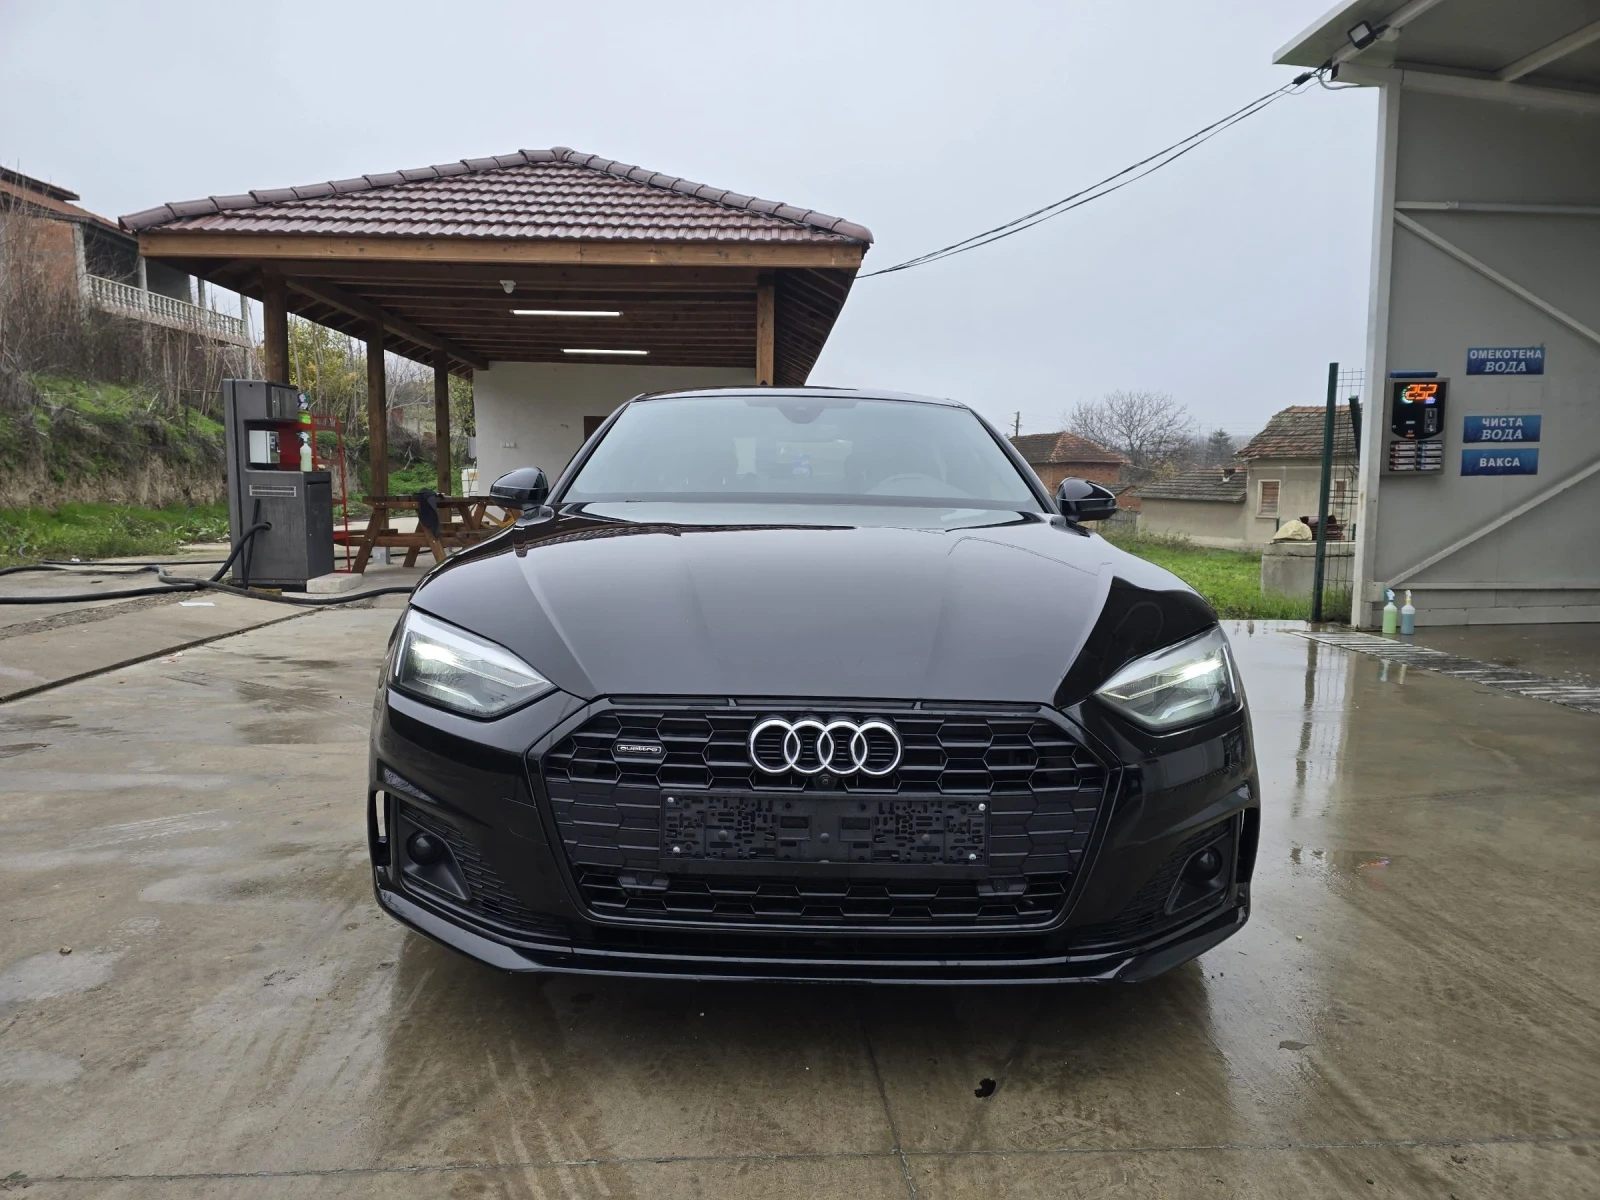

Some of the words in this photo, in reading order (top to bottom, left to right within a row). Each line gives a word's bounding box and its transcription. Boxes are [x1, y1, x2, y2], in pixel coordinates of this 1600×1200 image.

[1469, 349, 1542, 359] ОМЕКОТЕНА
[1484, 361, 1527, 373] ВОДА
[1482, 417, 1523, 427] ЧИСТА
[1481, 429, 1523, 441] ВОДА
[1479, 457, 1520, 467] ВАКСА
[619, 745, 659, 753] quattro
